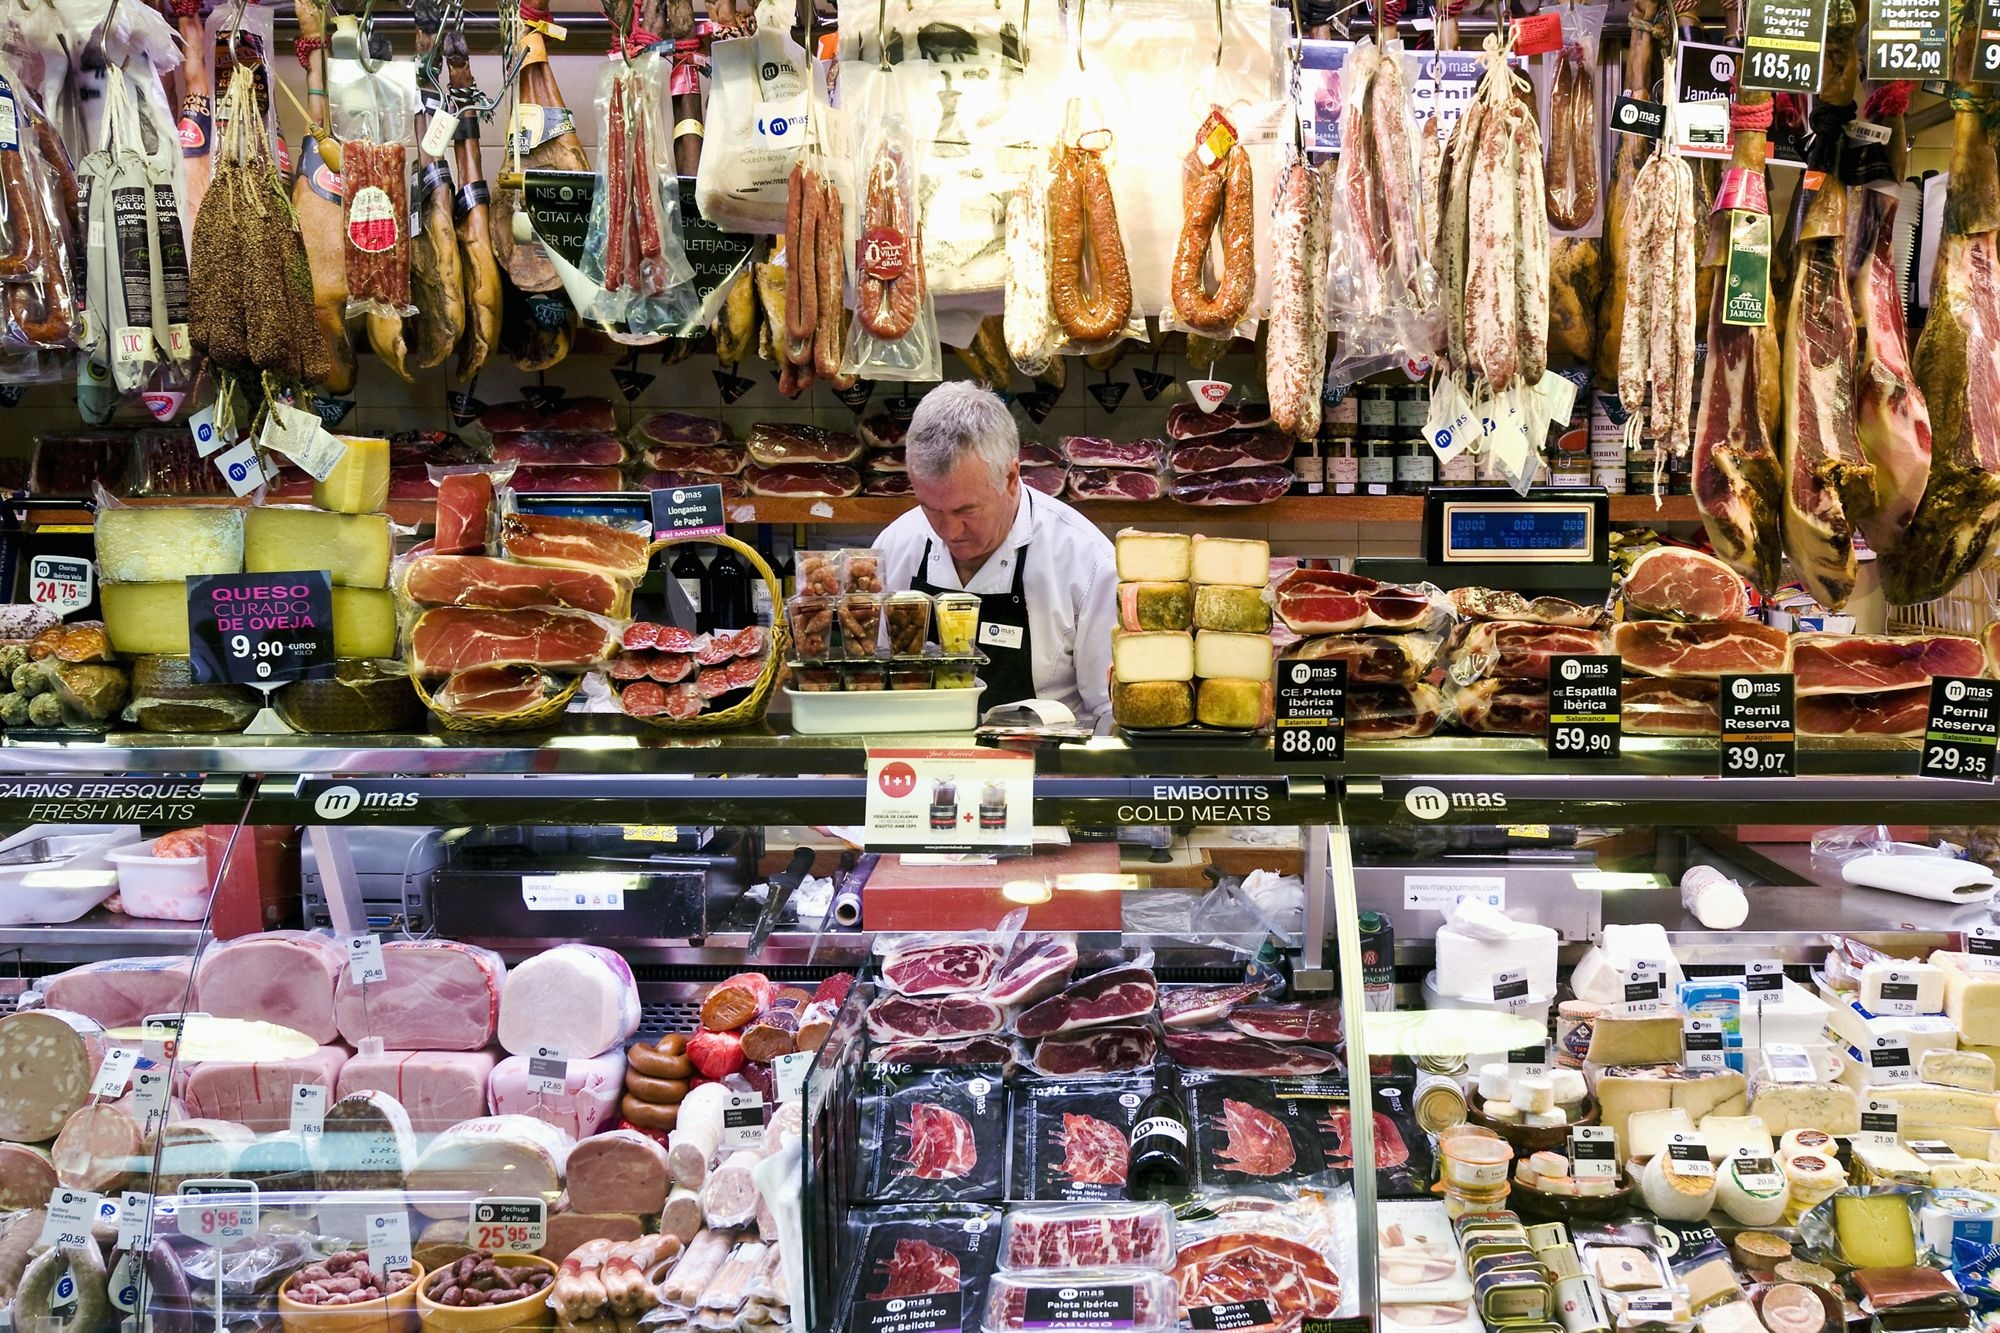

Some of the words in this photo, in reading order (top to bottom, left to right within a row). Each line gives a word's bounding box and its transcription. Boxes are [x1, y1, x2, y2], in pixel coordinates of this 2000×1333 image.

[1763, 4, 1812, 17] Pernil
[1877, 43, 1941, 71] 152,00
[1449, 61, 1476, 73] mas
[1751, 51, 1811, 82] 185,10
[1639, 111, 1661, 124] mas
[115, 194, 146, 204] RESER
[116, 202, 147, 212] SALGO
[117, 213, 147, 222] LLONGAN
[1730, 299, 1763, 312] CUYAR
[1730, 310, 1762, 320] JABUGO
[122, 335, 143, 352] VIC
[244, 453, 260, 469] ma
[685, 490, 703, 499] mas
[667, 504, 707, 516] Llonganissa
[673, 518, 683, 526] de
[684, 516, 704, 526] Pagès
[674, 527, 722, 537] MONTSENY
[1530, 537, 1563, 548] ESPAI
[58, 564, 78, 572] Chorizo
[212, 585, 310, 602] QUESO
[214, 601, 311, 617] CURADO
[218, 617, 244, 632] DE
[249, 615, 315, 630] OVEJA
[1001, 627, 1016, 635] mas
[231, 634, 284, 660] 9,90
[1312, 667, 1338, 678] mas
[1582, 662, 1608, 675] mas
[1754, 680, 1781, 694] mas
[1966, 684, 1993, 699] mas
[1289, 697, 1334, 707] ibérica
[1563, 699, 1607, 710] ibèrica
[1289, 707, 1333, 716] Bellota
[1733, 704, 1780, 716] Pernil
[1942, 704, 1989, 718] Pernil
[1284, 718, 1323, 727] Salamanca
[1566, 714, 1605, 722] Salamanca
[1725, 718, 1791, 729] Reserva
[1931, 717, 1997, 733] Reserva
[1282, 729, 1337, 754] 88,00
[1555, 727, 1611, 754] 59,90
[1745, 733, 1773, 742] Aragón
[1942, 733, 1983, 743] Salamanca
[1728, 746, 1786, 772] 39,07
[1927, 746, 1987, 774] 29,35
[76, 783, 202, 799] FRESQUES
[1153, 785, 1270, 800] EMBOTITS
[363, 791, 420, 807] mas
[1452, 791, 1507, 807] mas
[28, 804, 107, 819] FRESH
[114, 804, 196, 820] MEATS
[1117, 804, 1184, 821] COLD
[1192, 805, 1271, 821] MEATS
[1409, 882, 1500, 893] www.masgourmets.com
[364, 969, 383, 978] 20,40
[1763, 993, 1779, 1001] 8,70
[1509, 998, 1527, 1008] 14,05
[1638, 1003, 1657, 1011] 41,25
[1894, 1002, 1913, 1011] 12,25
[1701, 1054, 1721, 1062] 68,75
[1526, 1066, 1542, 1076] 3,60
[1888, 1069, 1909, 1078] 36,40
[542, 1080, 562, 1090] 12,85
[976, 1095, 986, 1115] mas
[1390, 1096, 1403, 1112] mas
[303, 1124, 321, 1133] 16,15
[1155, 1120, 1186, 1135] mas
[740, 1129, 762, 1139] 20,95
[1874, 1135, 1894, 1143] 21,00
[1596, 1163, 1613, 1172] 1,75
[1688, 1163, 1708, 1171] 20,75
[501, 1205, 530, 1214] Pechuga
[512, 1215, 529, 1223] Pavo
[60, 1232, 86, 1245] 20,55
[1681, 1227, 1717, 1242] ma
[968, 1234, 980, 1252] mas
[385, 1255, 408, 1265] 33,50
[907, 1297, 932, 1308] mas
[1047, 1300, 1080, 1309] Paleta
[1227, 1303, 1246, 1311] mas
[871, 1312, 907, 1324] Jamón
[1055, 1309, 1069, 1319] de
[1071, 1309, 1110, 1319] Bellota
[1214, 1311, 1250, 1323] Jamón
[881, 1324, 896, 1333] de
[897, 1319, 936, 1332] Bellota
